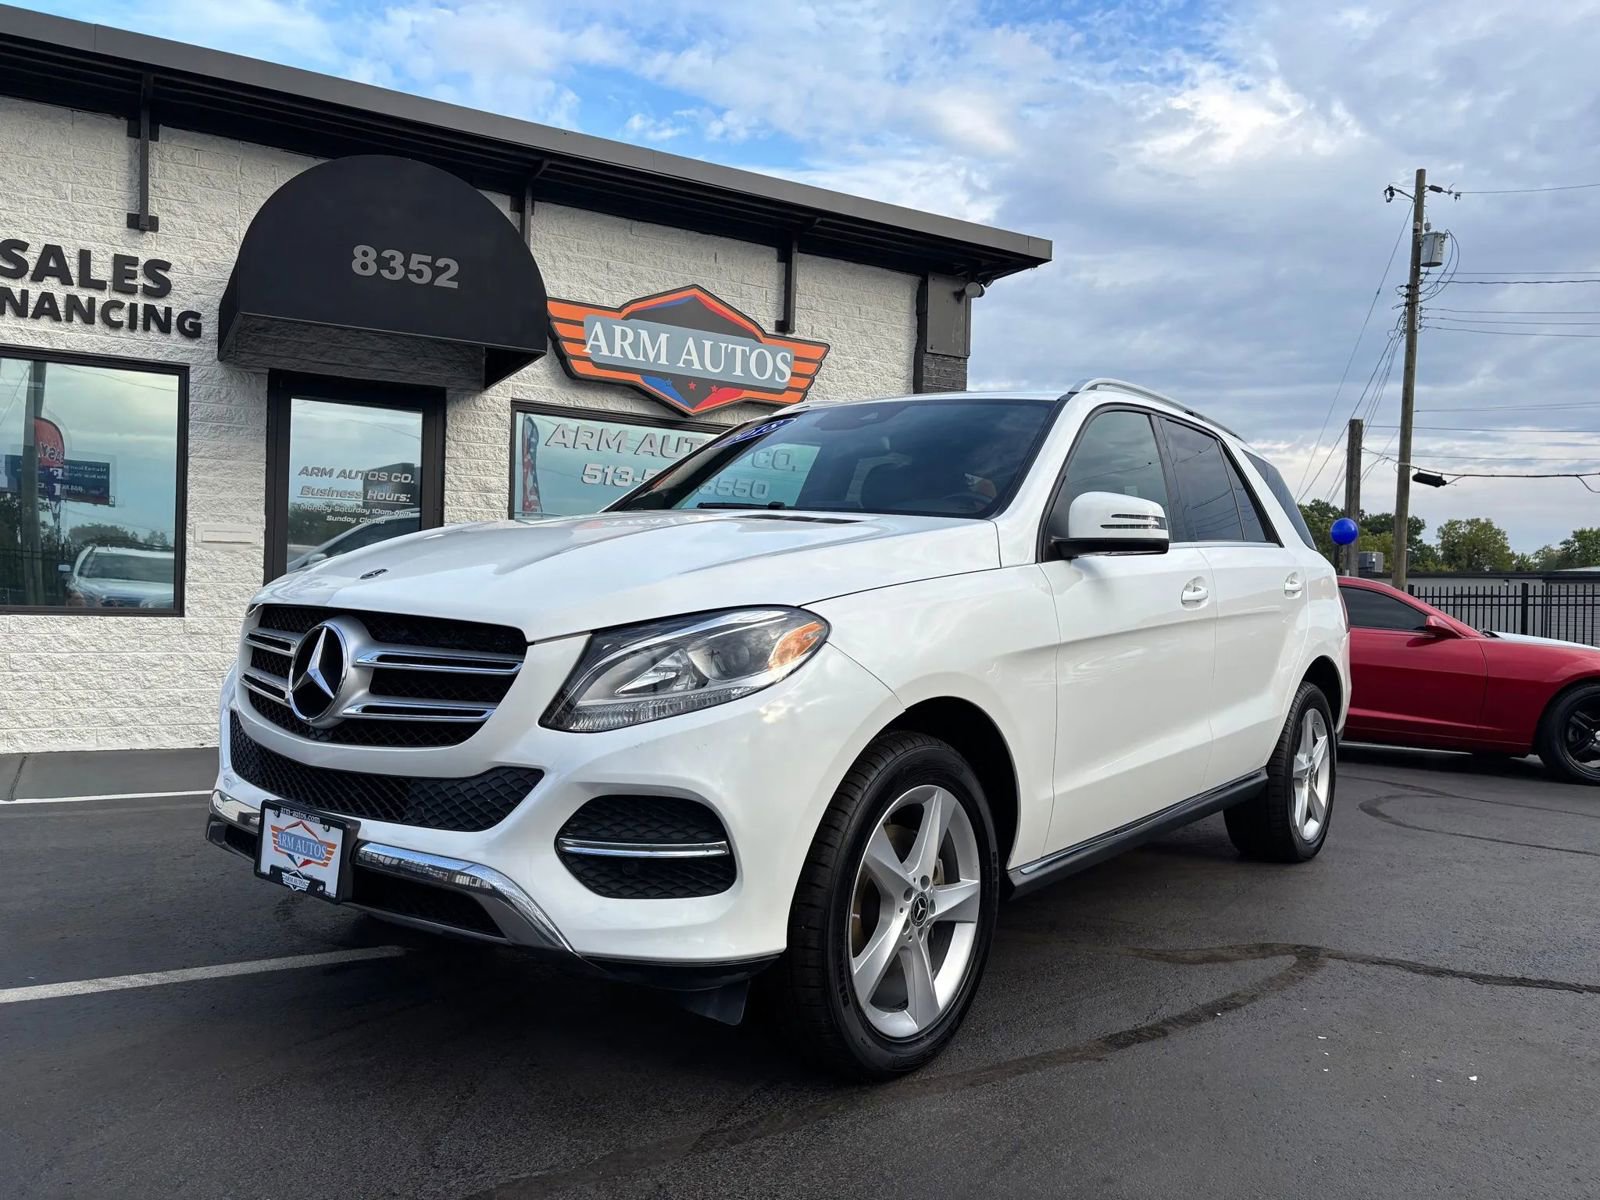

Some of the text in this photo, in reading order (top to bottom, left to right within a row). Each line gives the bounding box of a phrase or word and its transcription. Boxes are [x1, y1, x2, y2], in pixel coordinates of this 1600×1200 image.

[0, 238, 173, 299] SALES
[351, 244, 459, 289] 8352
[582, 321, 792, 384] ARM AUTOS
[545, 423, 630, 453] ARM
[634, 432, 710, 459] AUT
[752, 448, 796, 472] CO.
[298, 466, 415, 484] ARM AUTOS CO.
[301, 486, 411, 502] Business Hours:
[326, 515, 356, 523] Sunday
[281, 807, 320, 823] arm-autos.com
[295, 839, 327, 859] AUTOS
